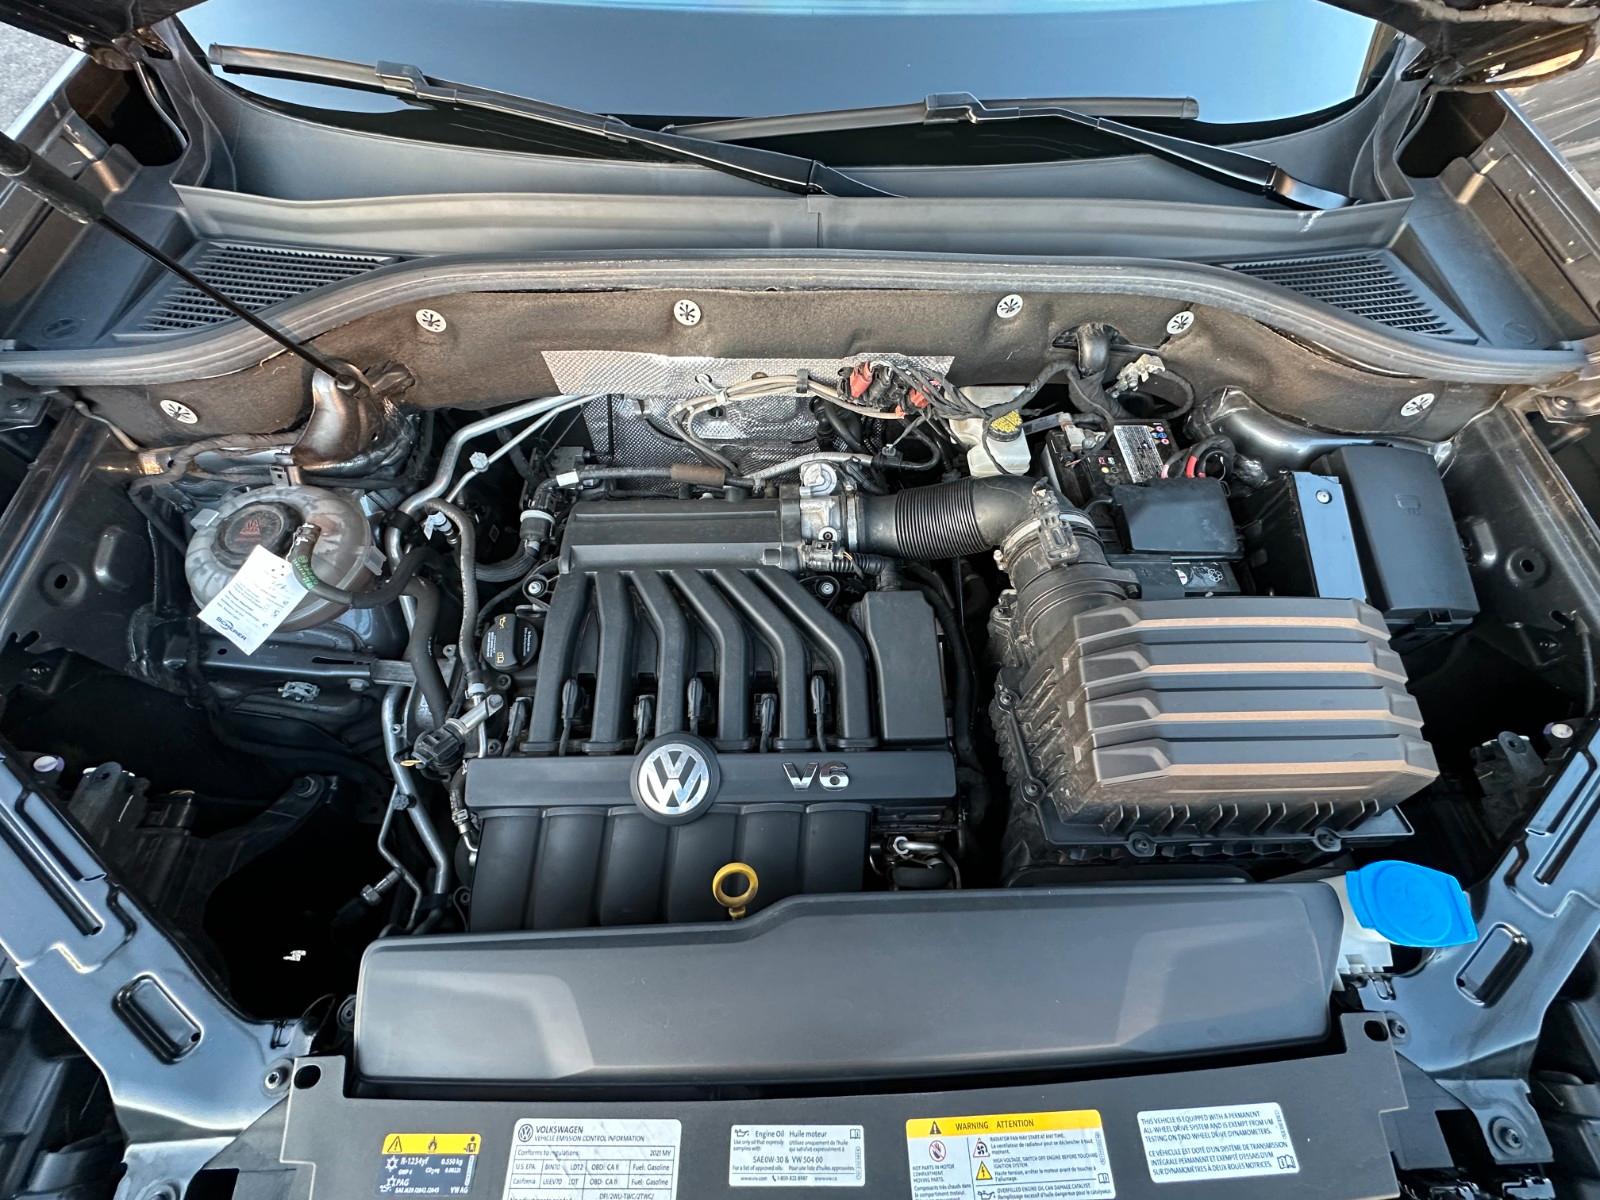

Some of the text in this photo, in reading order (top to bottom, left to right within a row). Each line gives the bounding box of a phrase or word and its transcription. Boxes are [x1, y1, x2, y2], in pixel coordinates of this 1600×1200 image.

[783, 761, 849, 791] V6
[1154, 1116, 1175, 1124] VEHICLE
[1182, 1114, 1209, 1123] EQUIPPED
[1229, 1111, 1260, 1119] PERMANENT
[956, 1119, 1034, 1131] WARNING ATTENTION
[1228, 1120, 1248, 1128] EXEMPT
[1249, 1119, 1264, 1127] FROM
[536, 1126, 584, 1134] VOLKSWAGEN
[755, 1130, 775, 1139] Engine
[790, 1130, 804, 1138] Huile
[1250, 1141, 1288, 1150] TRANSMISSION
[396, 1178, 410, 1186] PAG
